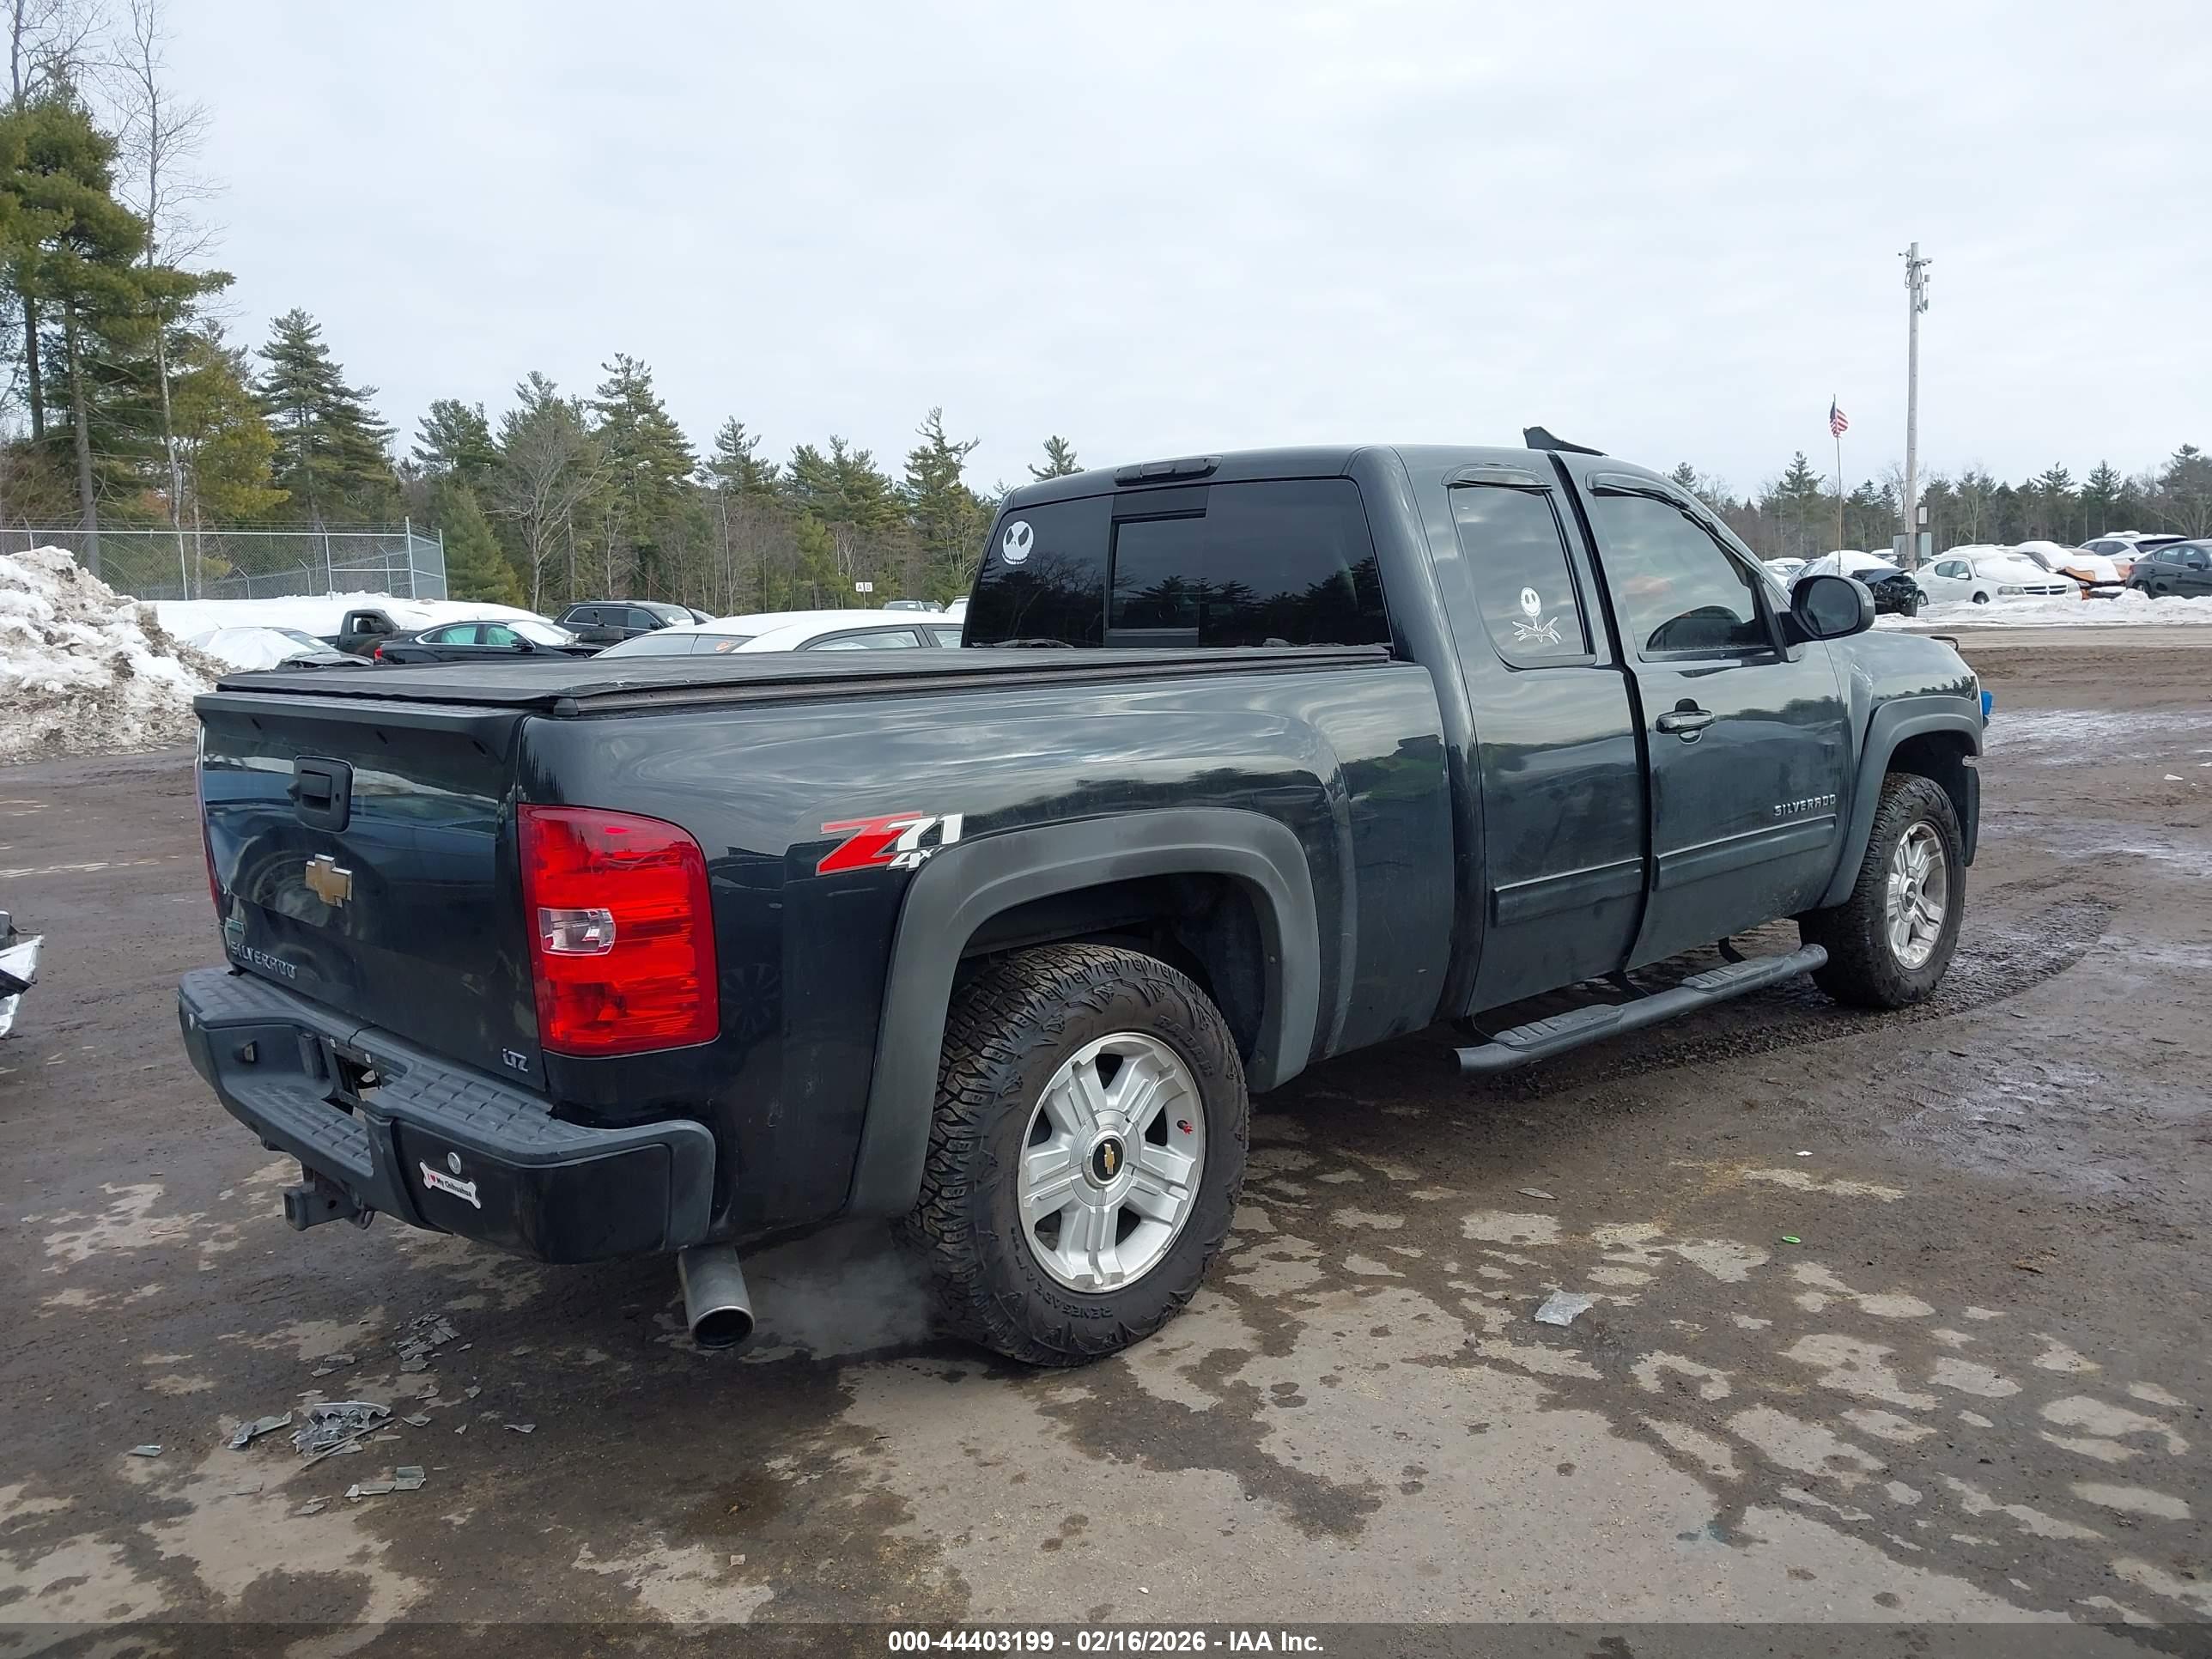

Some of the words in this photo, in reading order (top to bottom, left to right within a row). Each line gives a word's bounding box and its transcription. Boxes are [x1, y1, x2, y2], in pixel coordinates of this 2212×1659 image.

[1773, 793, 1836, 817] SILVERADO
[816, 811, 965, 876] Z71
[230, 940, 297, 980] SILVERADO
[502, 1048, 529, 1073] LTZ
[436, 1176, 445, 1188] My
[445, 1180, 472, 1198] Chihuahua
